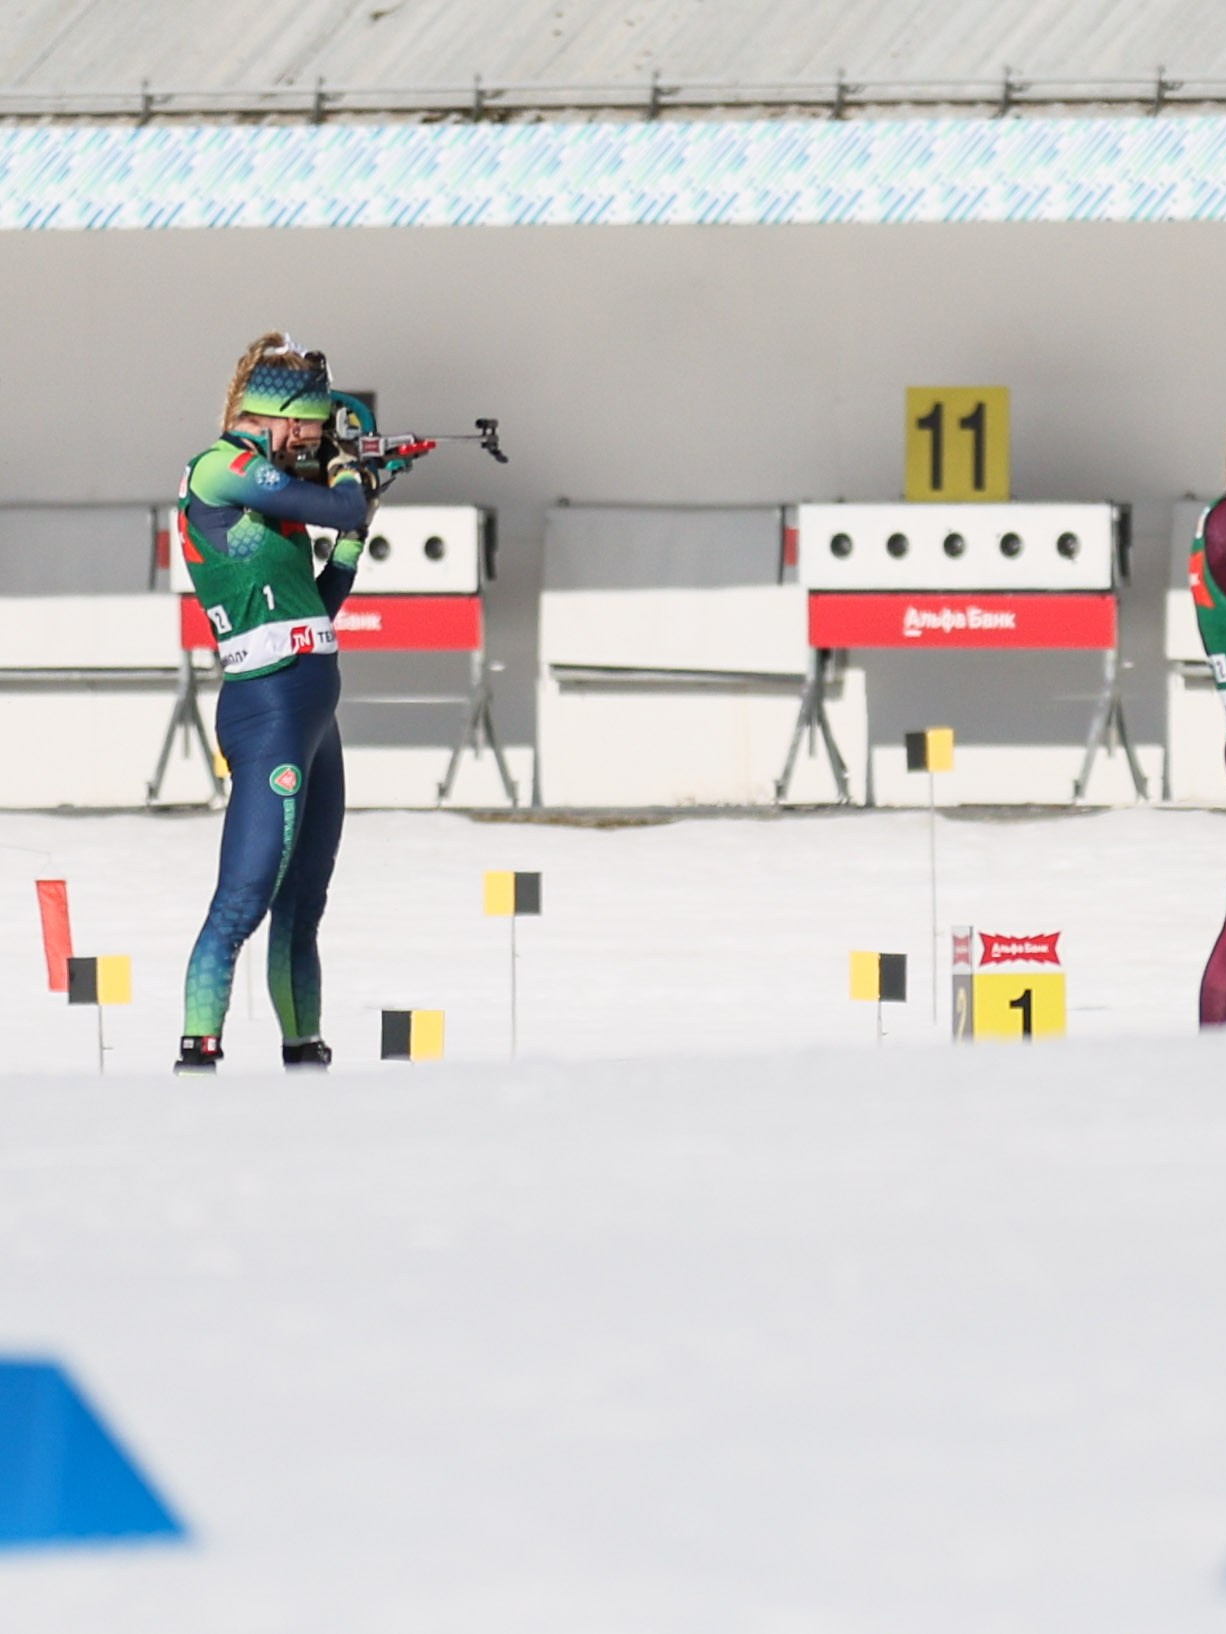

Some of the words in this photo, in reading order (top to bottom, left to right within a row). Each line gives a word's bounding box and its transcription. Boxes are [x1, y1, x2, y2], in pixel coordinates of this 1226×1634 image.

[915, 401, 986, 491] 11
[263, 584, 275, 610] 1
[903, 606, 966, 637] Альфа
[966, 606, 1016, 629] Банк
[1009, 989, 1032, 1039] 1
